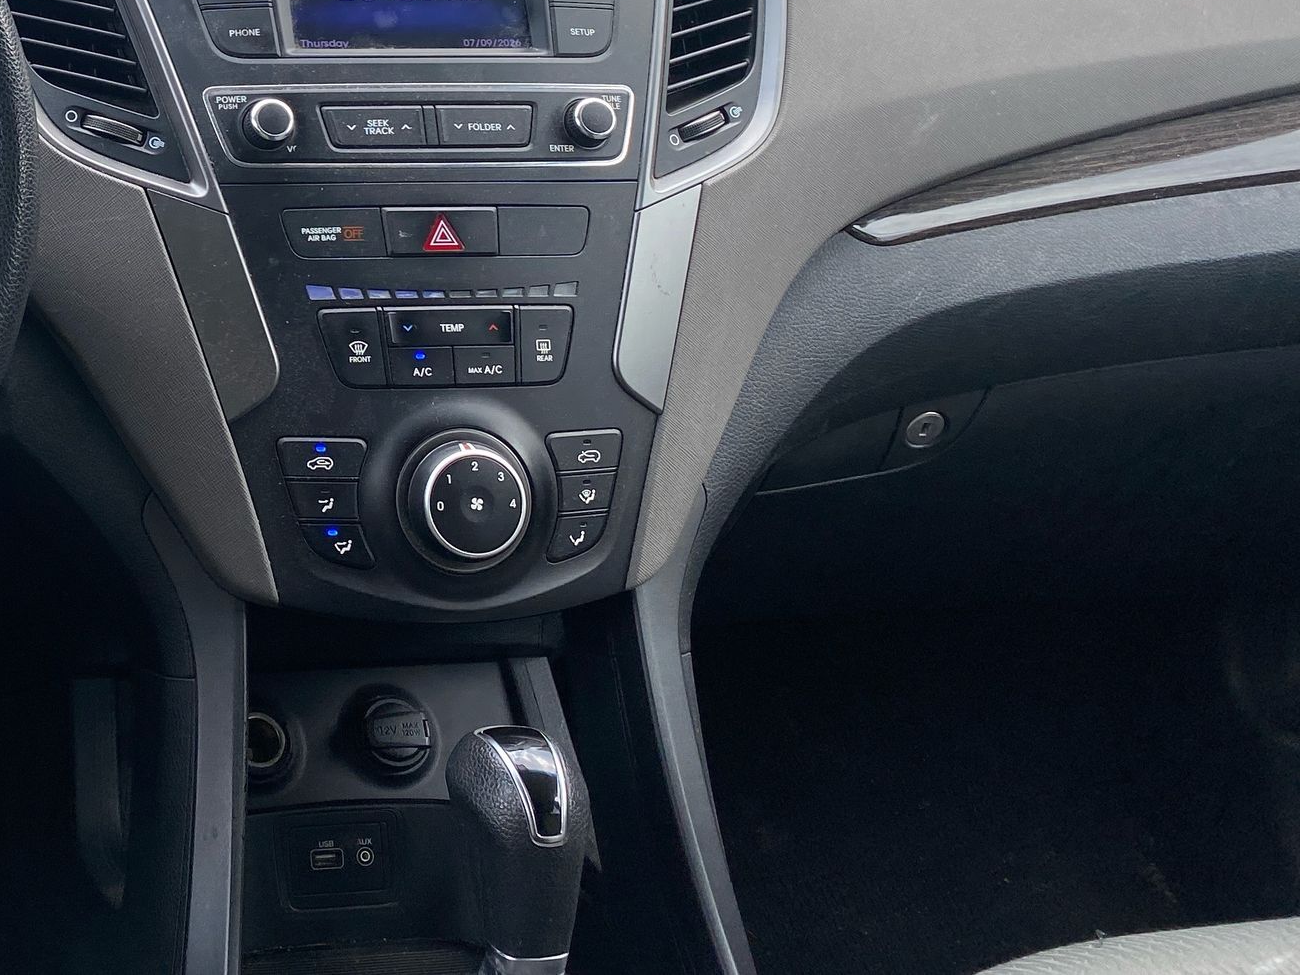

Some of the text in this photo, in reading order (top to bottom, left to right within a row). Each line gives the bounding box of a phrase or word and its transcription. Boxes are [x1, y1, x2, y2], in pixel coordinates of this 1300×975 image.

[229, 28, 261, 37] PHONE
[570, 28, 595, 36] SETUP
[300, 39, 349, 49] Thursday
[216, 96, 247, 104] POWER
[367, 119, 389, 127] SEEK
[468, 123, 502, 131] FOLDER
[363, 127, 395, 135] TRACK
[301, 227, 342, 235] PASSENGER
[344, 228, 364, 239] OFF
[307, 234, 337, 242] AIR BAG
[440, 324, 464, 332] TEMP
[413, 367, 432, 377] A/C
[484, 365, 503, 375] A/C
[471, 461, 479, 472] 2
[446, 474, 452, 485] 1
[497, 471, 505, 482] 3
[437, 501, 444, 512] 0
[509, 498, 517, 508] 4
[318, 840, 334, 848] USB
[357, 838, 373, 846] AUX
